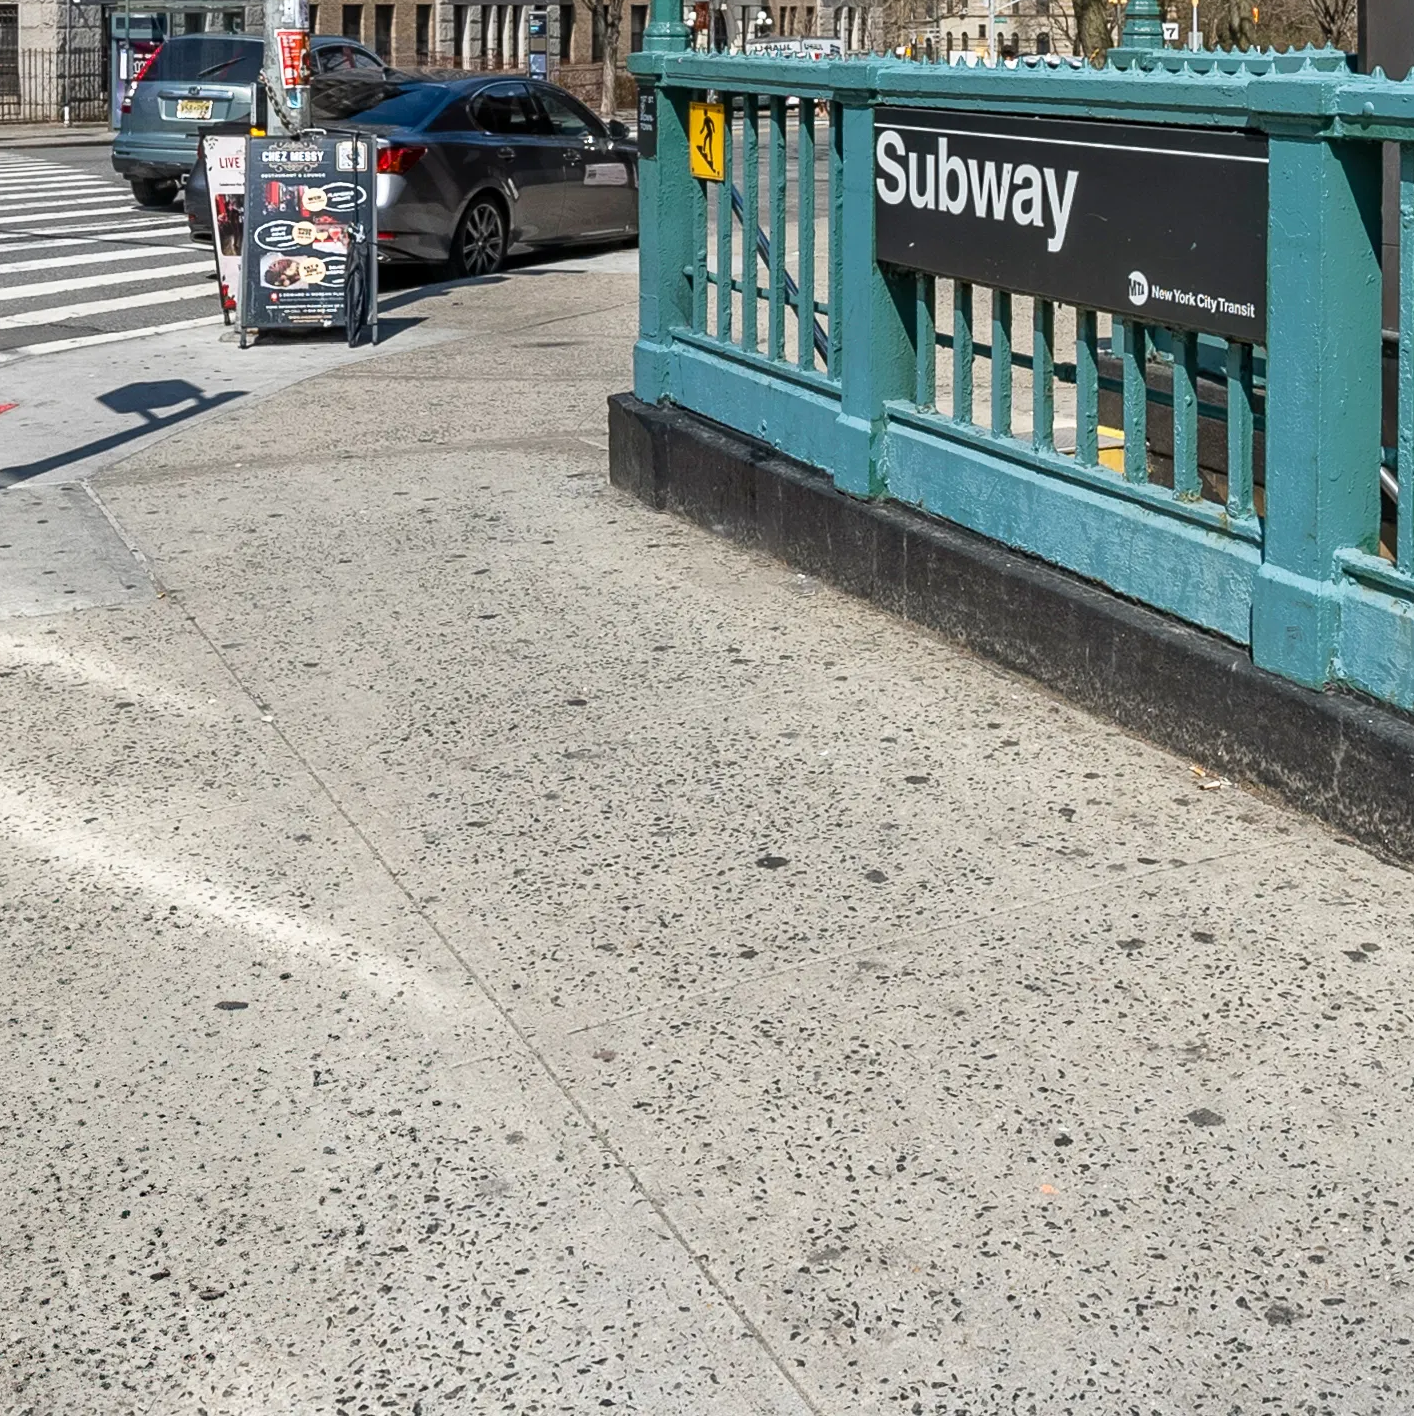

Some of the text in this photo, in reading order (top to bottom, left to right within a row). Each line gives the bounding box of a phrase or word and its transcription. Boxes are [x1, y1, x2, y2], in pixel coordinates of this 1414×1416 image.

[1165, 28, 1176, 38] 7
[262, 151, 324, 162] CHEZ MESSY
[219, 157, 240, 168] LIVE
[875, 130, 1079, 252] Subway
[1128, 274, 1255, 318] MTA New York City Transit
